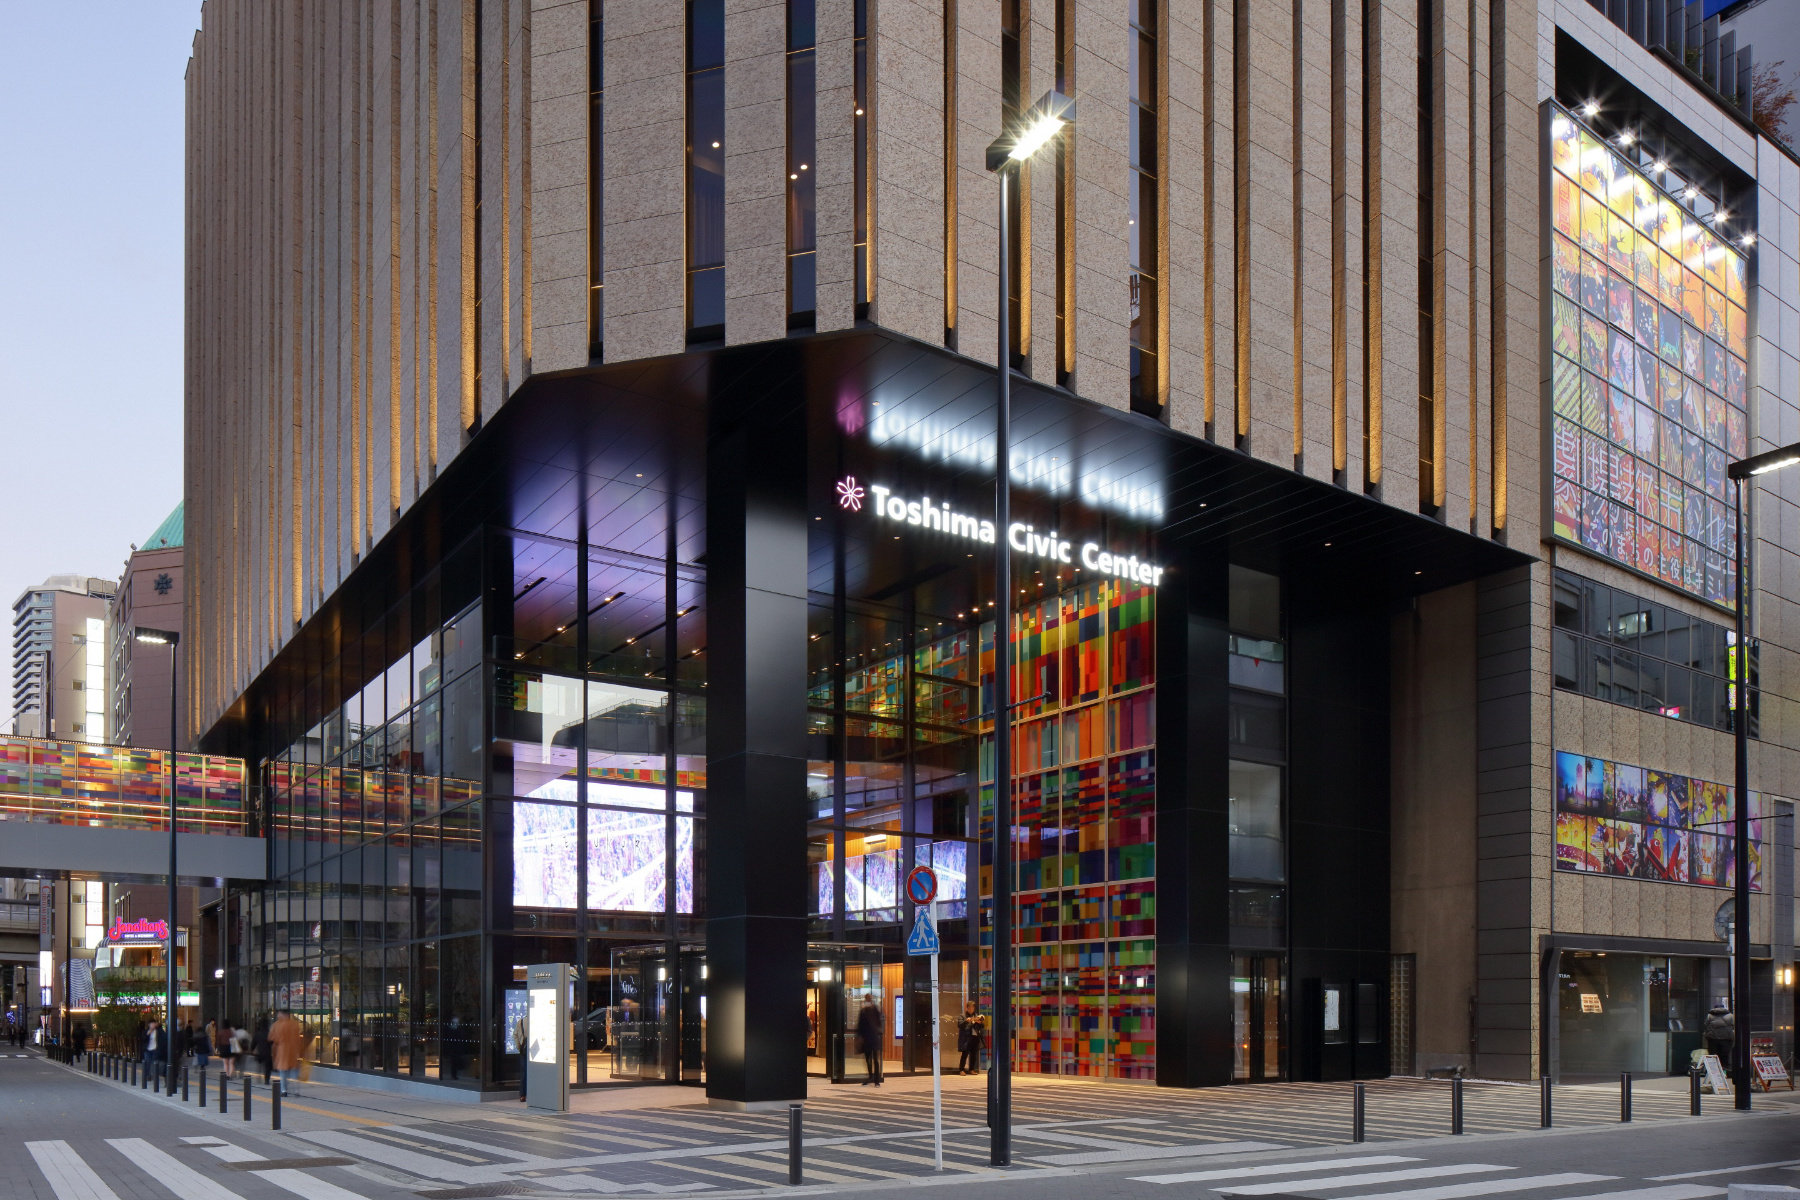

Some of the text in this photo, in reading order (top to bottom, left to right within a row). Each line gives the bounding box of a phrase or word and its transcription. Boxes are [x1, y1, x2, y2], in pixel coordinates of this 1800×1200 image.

[871, 484, 1164, 585] Toshima Civic Center
